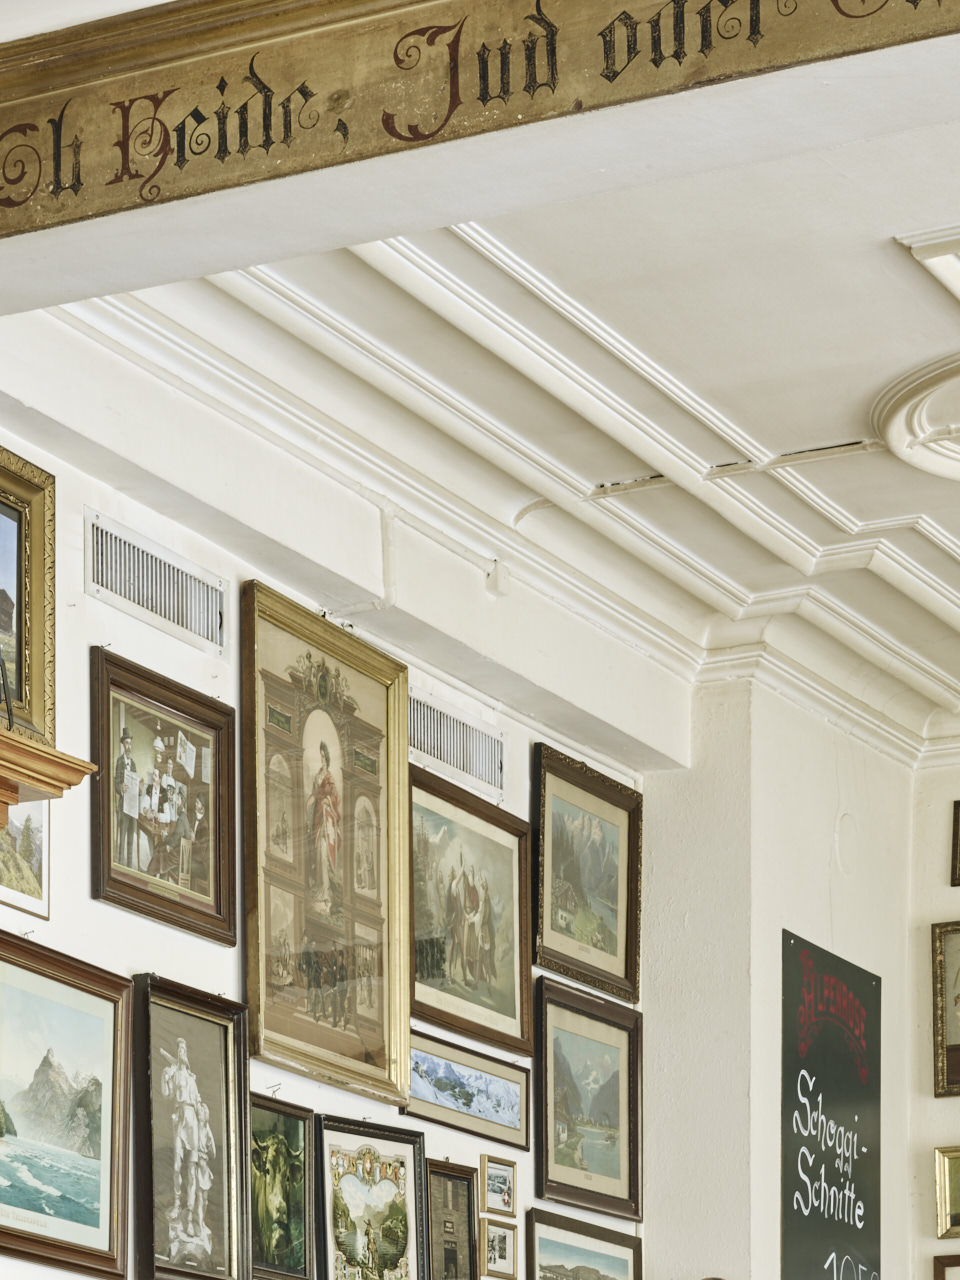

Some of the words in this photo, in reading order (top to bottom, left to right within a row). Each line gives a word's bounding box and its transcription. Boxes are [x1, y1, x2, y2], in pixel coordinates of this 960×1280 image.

[381, 0, 561, 142] Jud
[793, 1069, 867, 1177] Schoggi-
[793, 1145, 865, 1229] Schnitte
